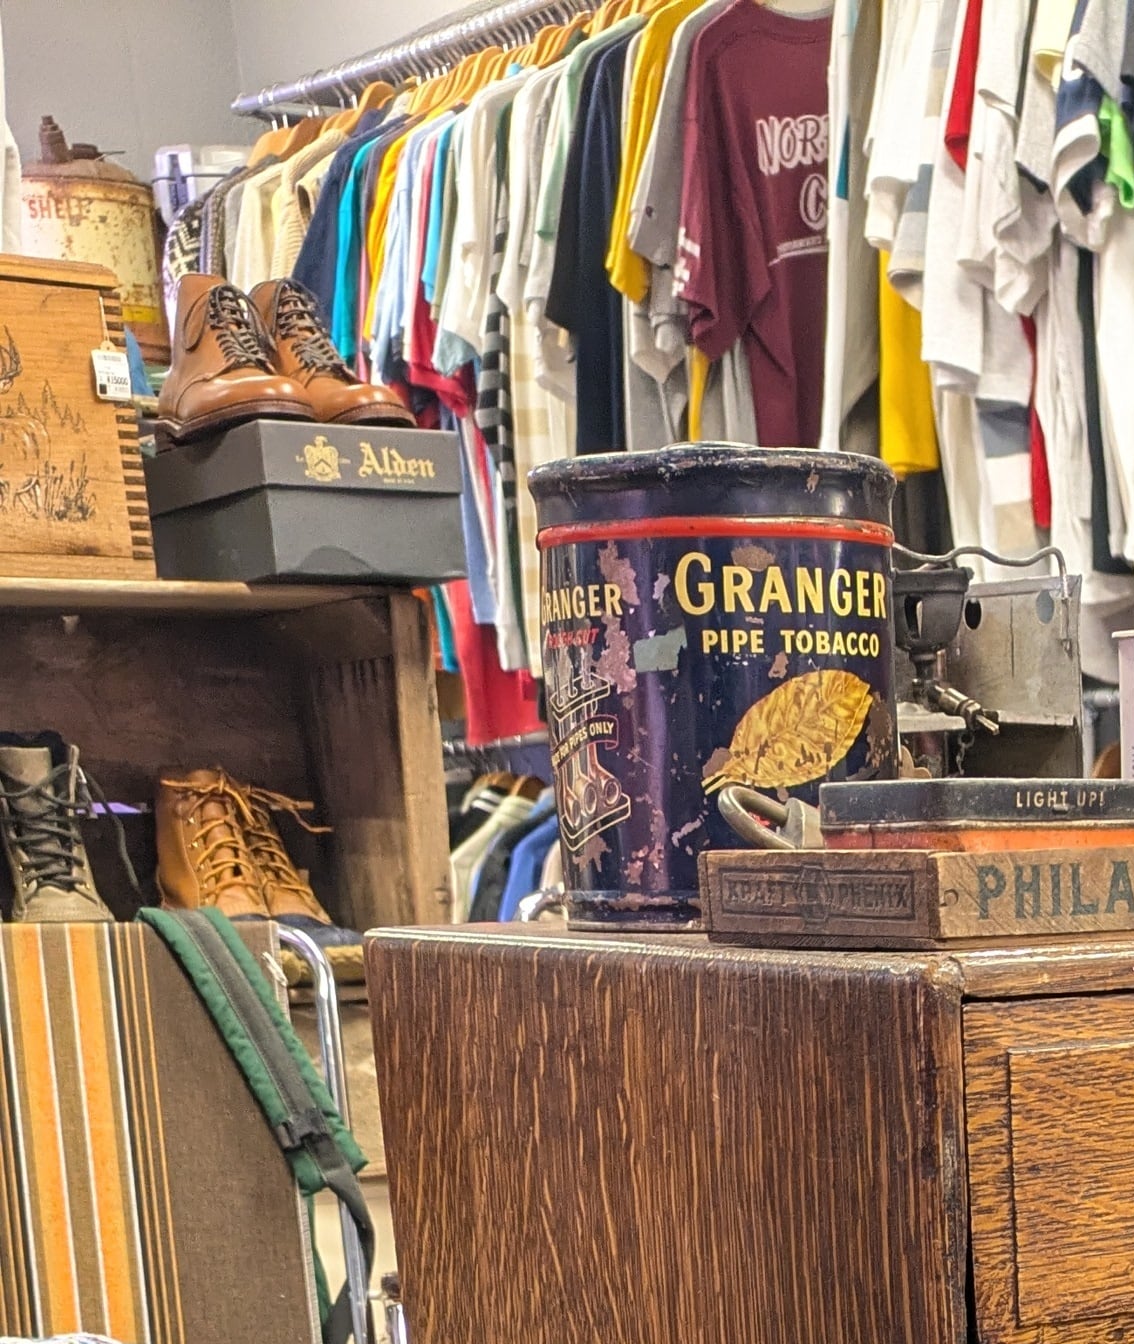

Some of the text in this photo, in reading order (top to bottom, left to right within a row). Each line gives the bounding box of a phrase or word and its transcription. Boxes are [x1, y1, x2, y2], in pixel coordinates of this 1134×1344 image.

[358, 441, 436, 478] Alden
[674, 551, 887, 620] GRANGER
[541, 583, 624, 627] GRANGER
[702, 629, 880, 657] PIPE TOBACCO
[589, 720, 615, 737] ONLY
[1015, 790, 1069, 809] LIGHT
